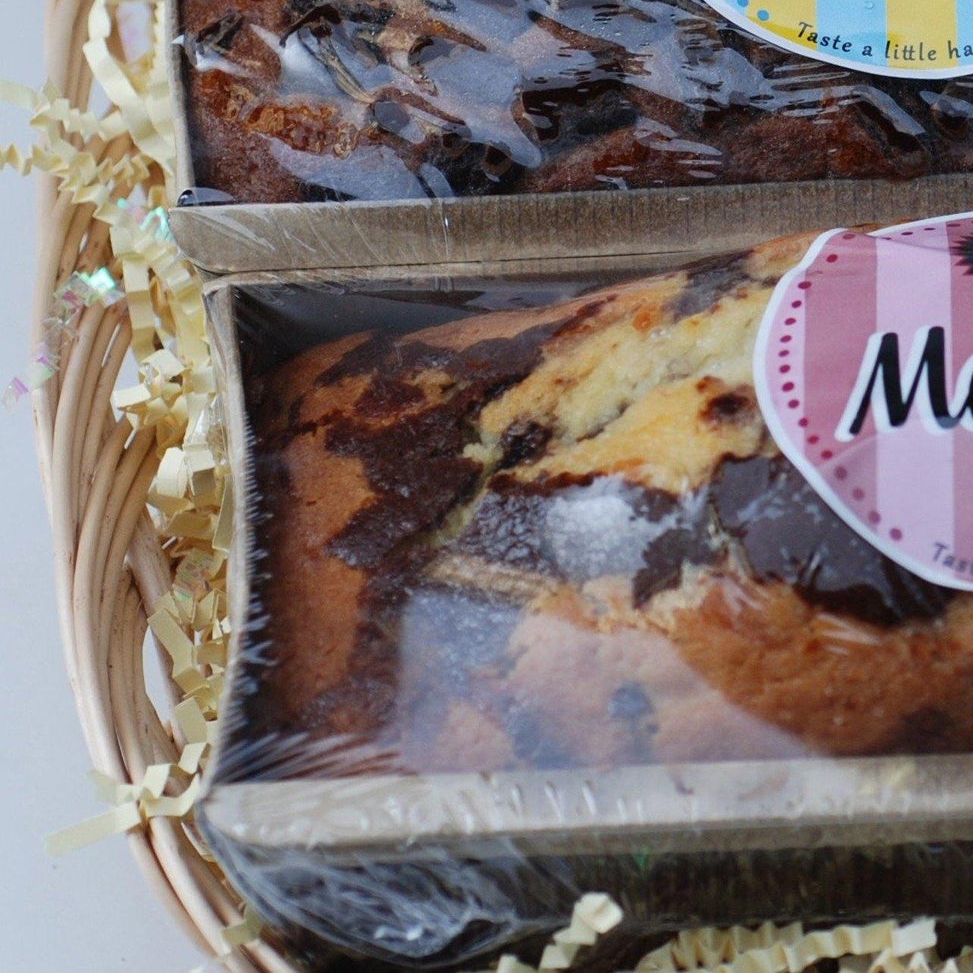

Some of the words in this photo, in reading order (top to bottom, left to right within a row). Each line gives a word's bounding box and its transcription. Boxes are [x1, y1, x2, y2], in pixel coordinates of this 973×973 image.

[798, 21, 852, 53] Taste
[861, 44, 873, 56] a
[884, 40, 937, 61] little
